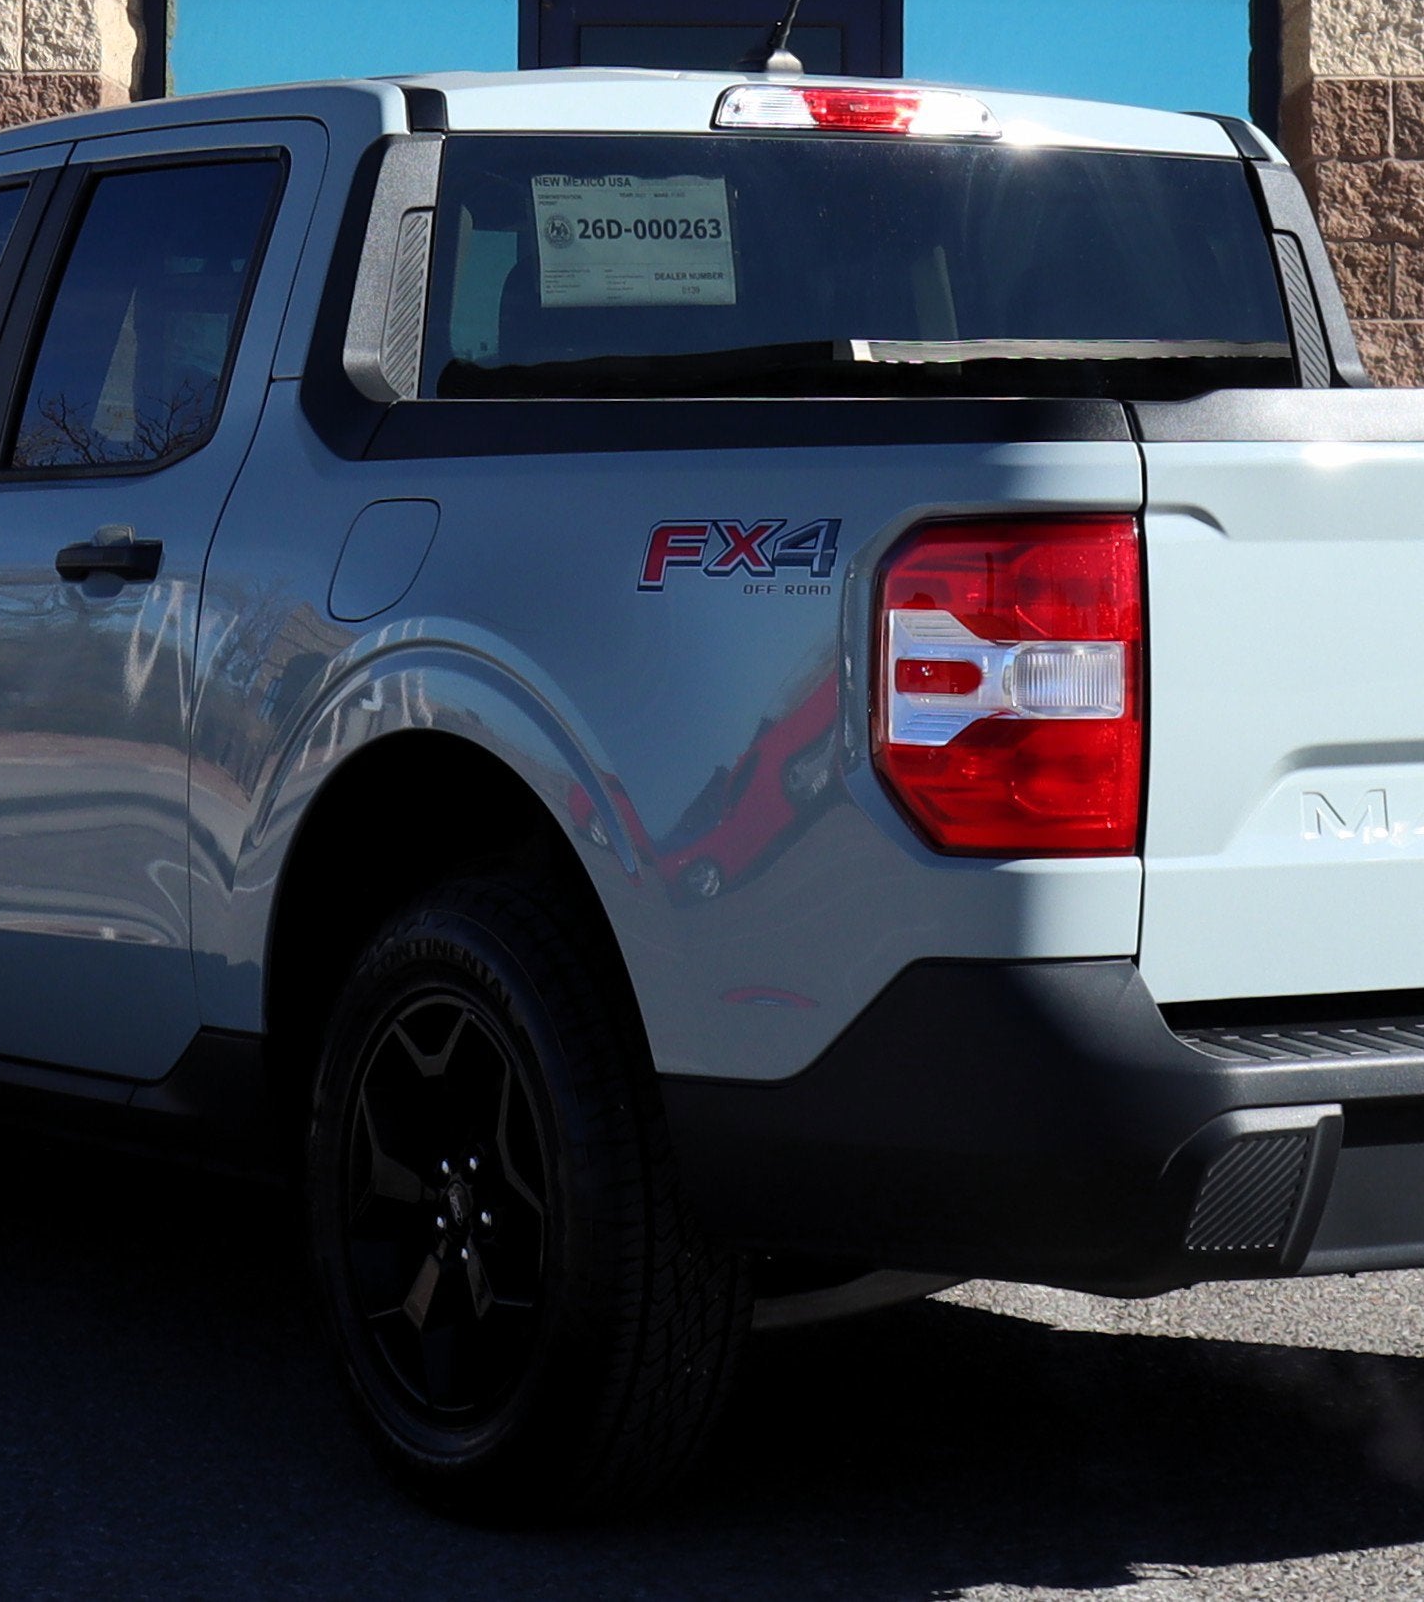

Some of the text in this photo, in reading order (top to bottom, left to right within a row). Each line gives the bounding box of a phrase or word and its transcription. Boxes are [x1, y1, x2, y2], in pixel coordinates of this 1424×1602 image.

[534, 176, 632, 188] NEW MEXICO USA
[577, 218, 722, 240] 26D-000263
[654, 272, 724, 281] DEALER NUMBER
[636, 518, 843, 593] FX4
[743, 585, 831, 596] OFF ROAD
